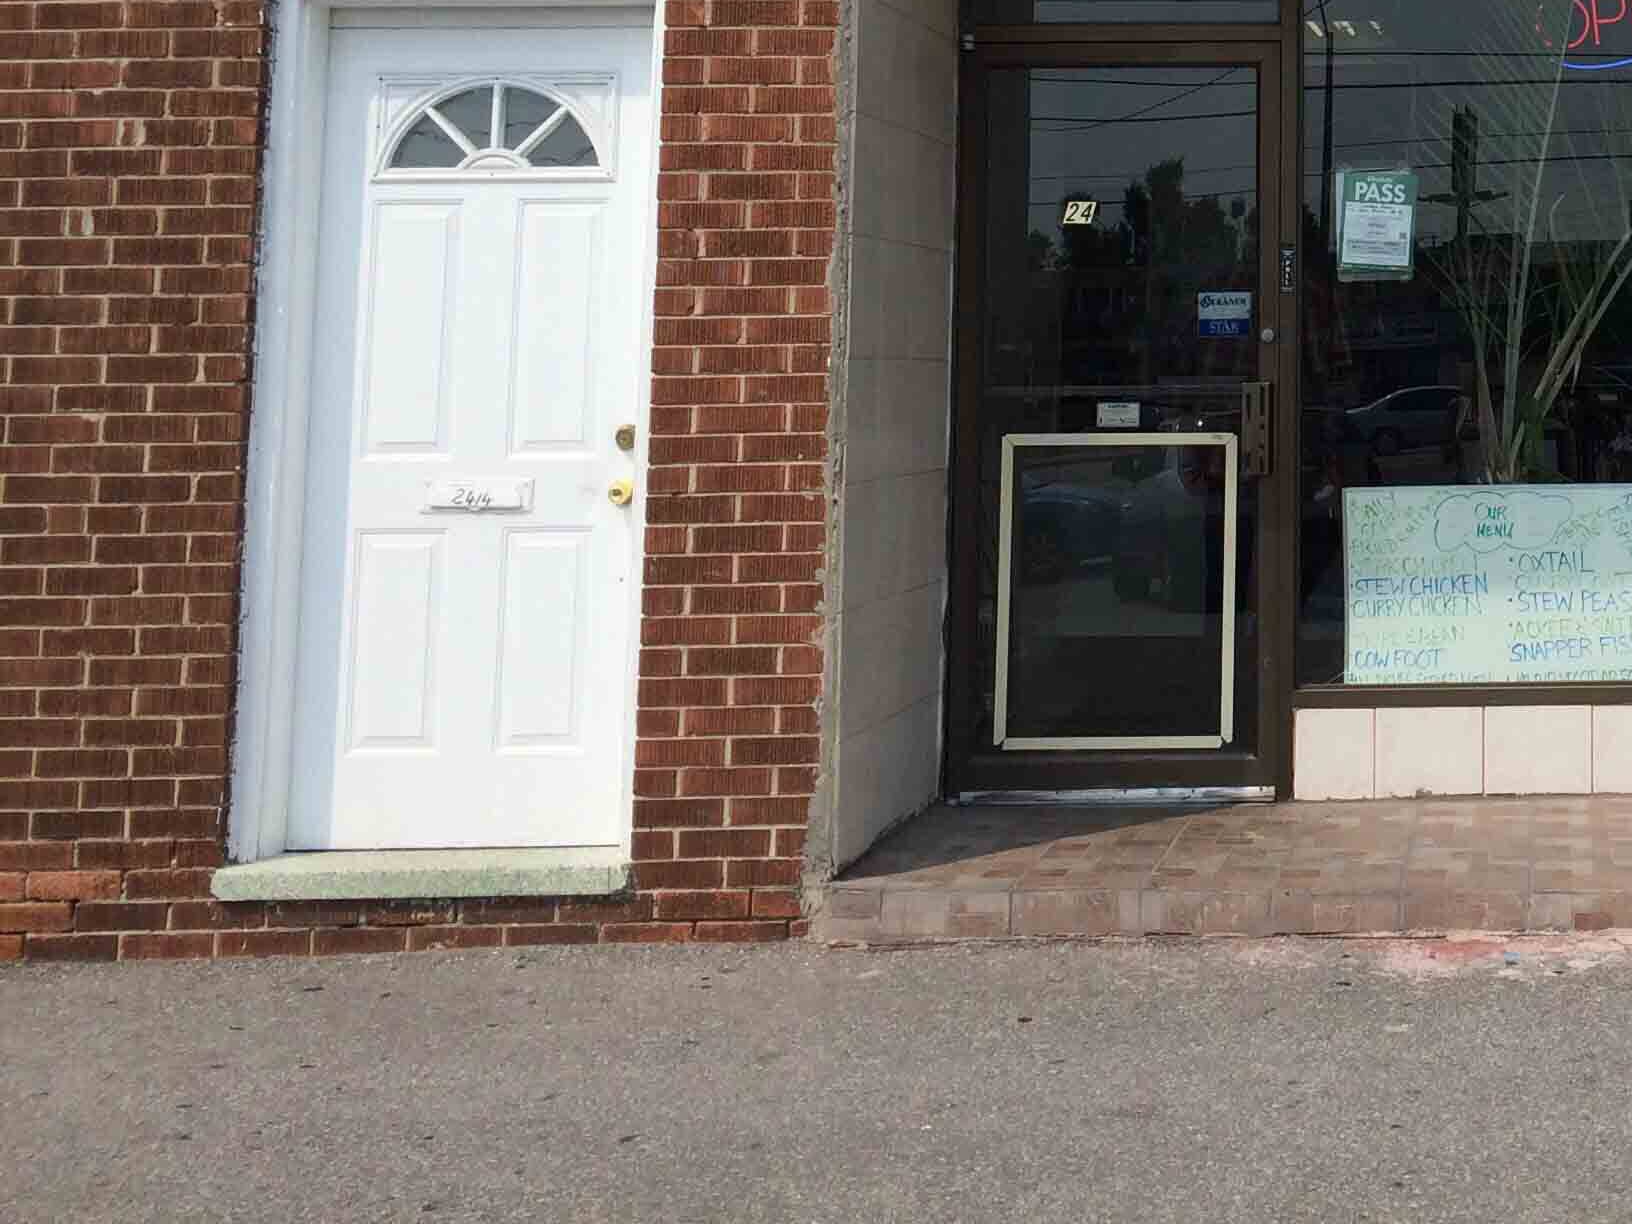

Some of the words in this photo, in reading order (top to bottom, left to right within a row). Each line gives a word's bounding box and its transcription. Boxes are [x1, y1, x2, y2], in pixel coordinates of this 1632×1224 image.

[1355, 181, 1406, 203] PASS
[1065, 202, 1093, 222] 24
[1518, 551, 1595, 573] OXTAIL
[1354, 577, 1406, 597] STEW
[1408, 572, 1488, 597] CHICKEN
[1517, 590, 1574, 614] STEW
[1581, 589, 1632, 613] PEAS
[1510, 637, 1593, 663] SNAPPER
